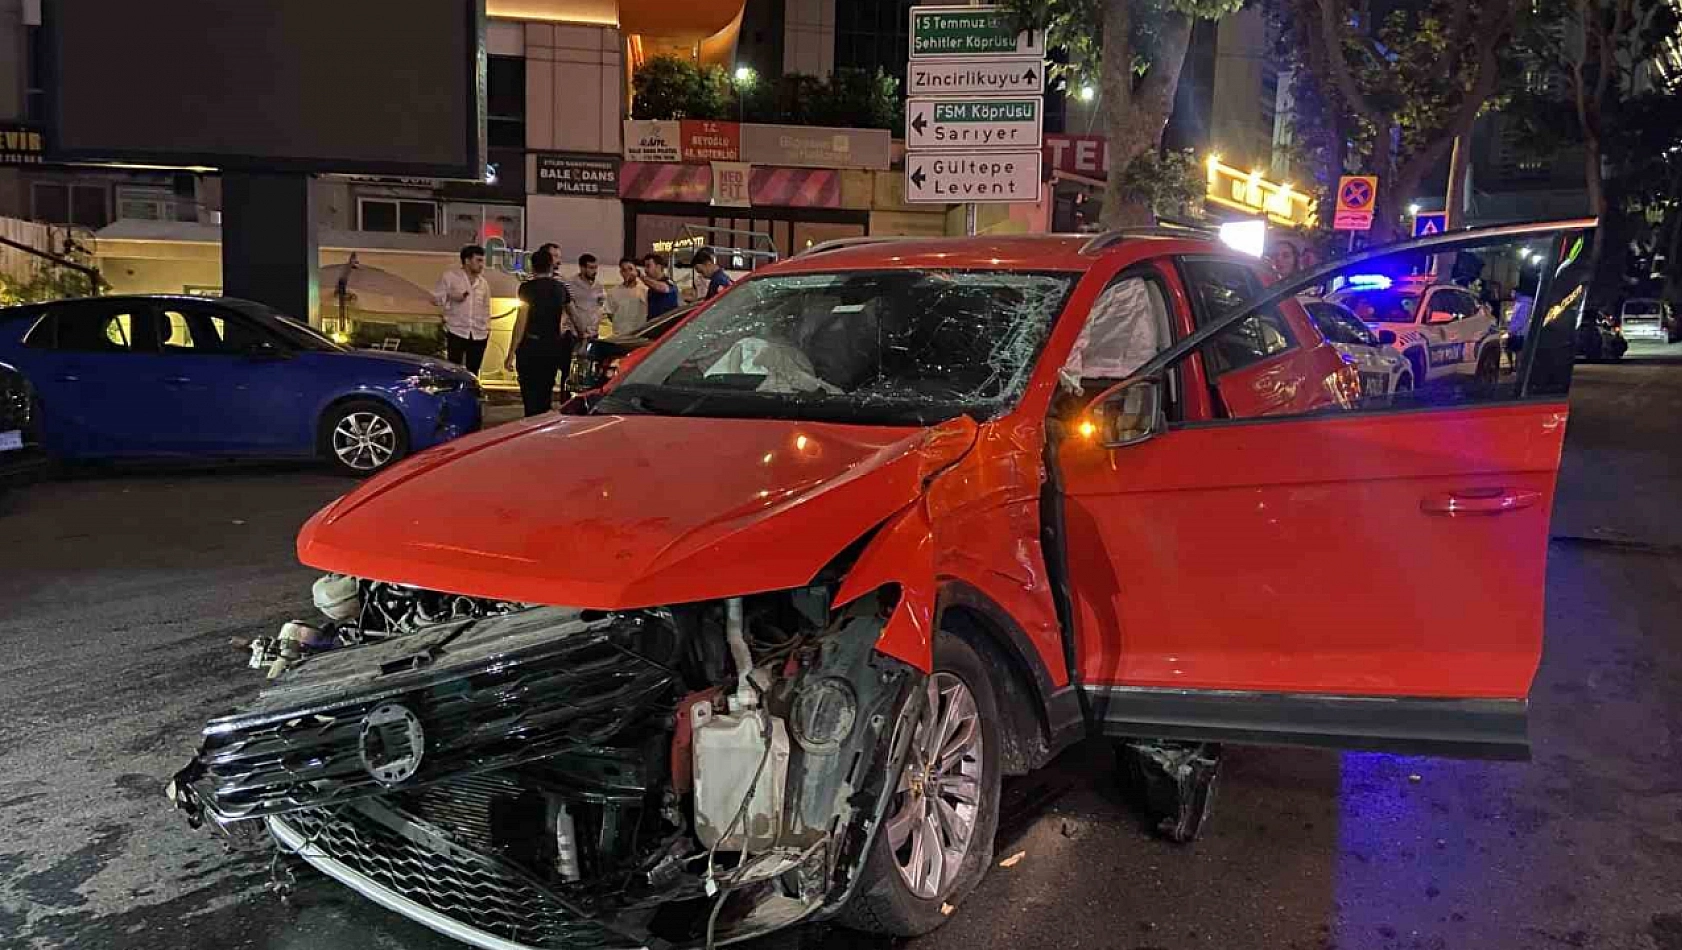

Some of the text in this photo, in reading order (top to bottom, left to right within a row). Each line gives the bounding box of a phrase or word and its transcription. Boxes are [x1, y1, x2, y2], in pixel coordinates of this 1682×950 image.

[916, 16, 930, 29] 15
[933, 16, 985, 29] Temmuz
[916, 70, 1020, 88] Zincirlikuyu
[936, 104, 1032, 121] FSM Köprüsü
[934, 126, 1018, 143] Sarıyer
[540, 168, 616, 182] BALE DANS
[933, 160, 1015, 178] Gültepe
[934, 180, 1016, 194] Levent
